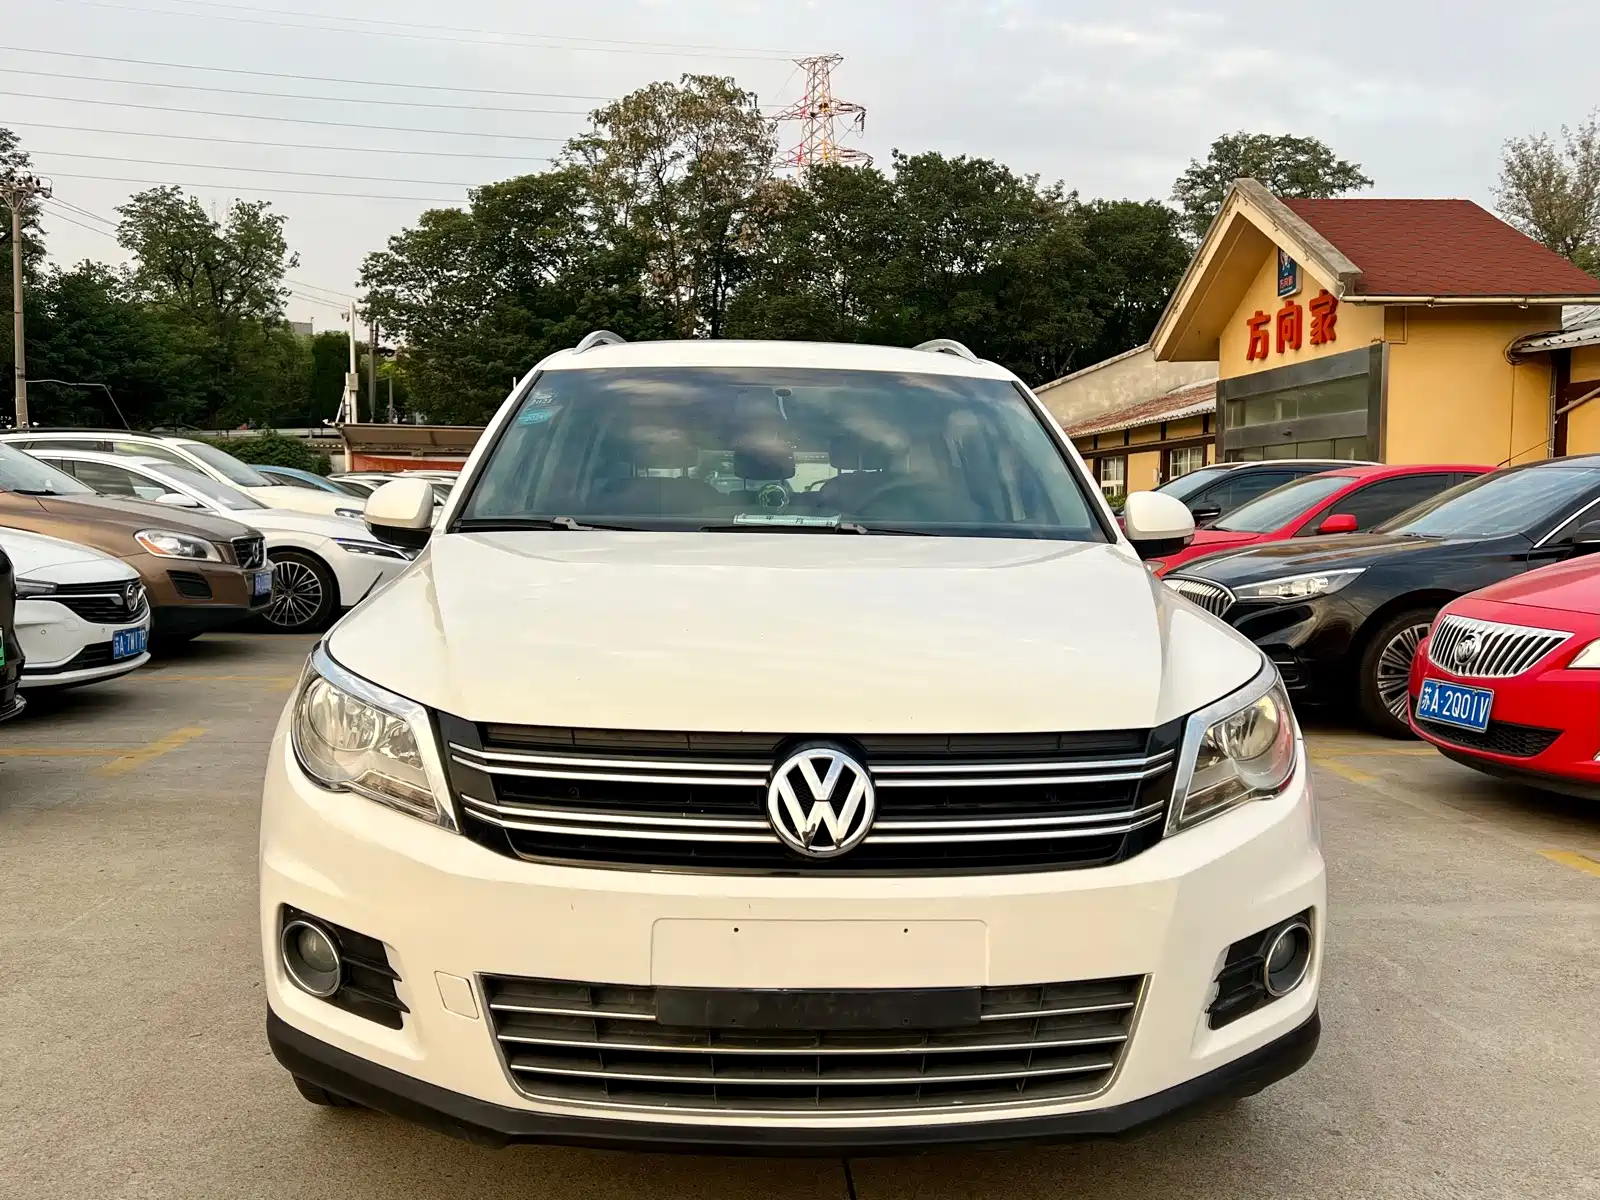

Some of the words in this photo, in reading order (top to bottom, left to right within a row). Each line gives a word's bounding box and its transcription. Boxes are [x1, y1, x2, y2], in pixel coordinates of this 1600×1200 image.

[1246, 288, 1339, 361] 方向家
[772, 752, 870, 852] VW
